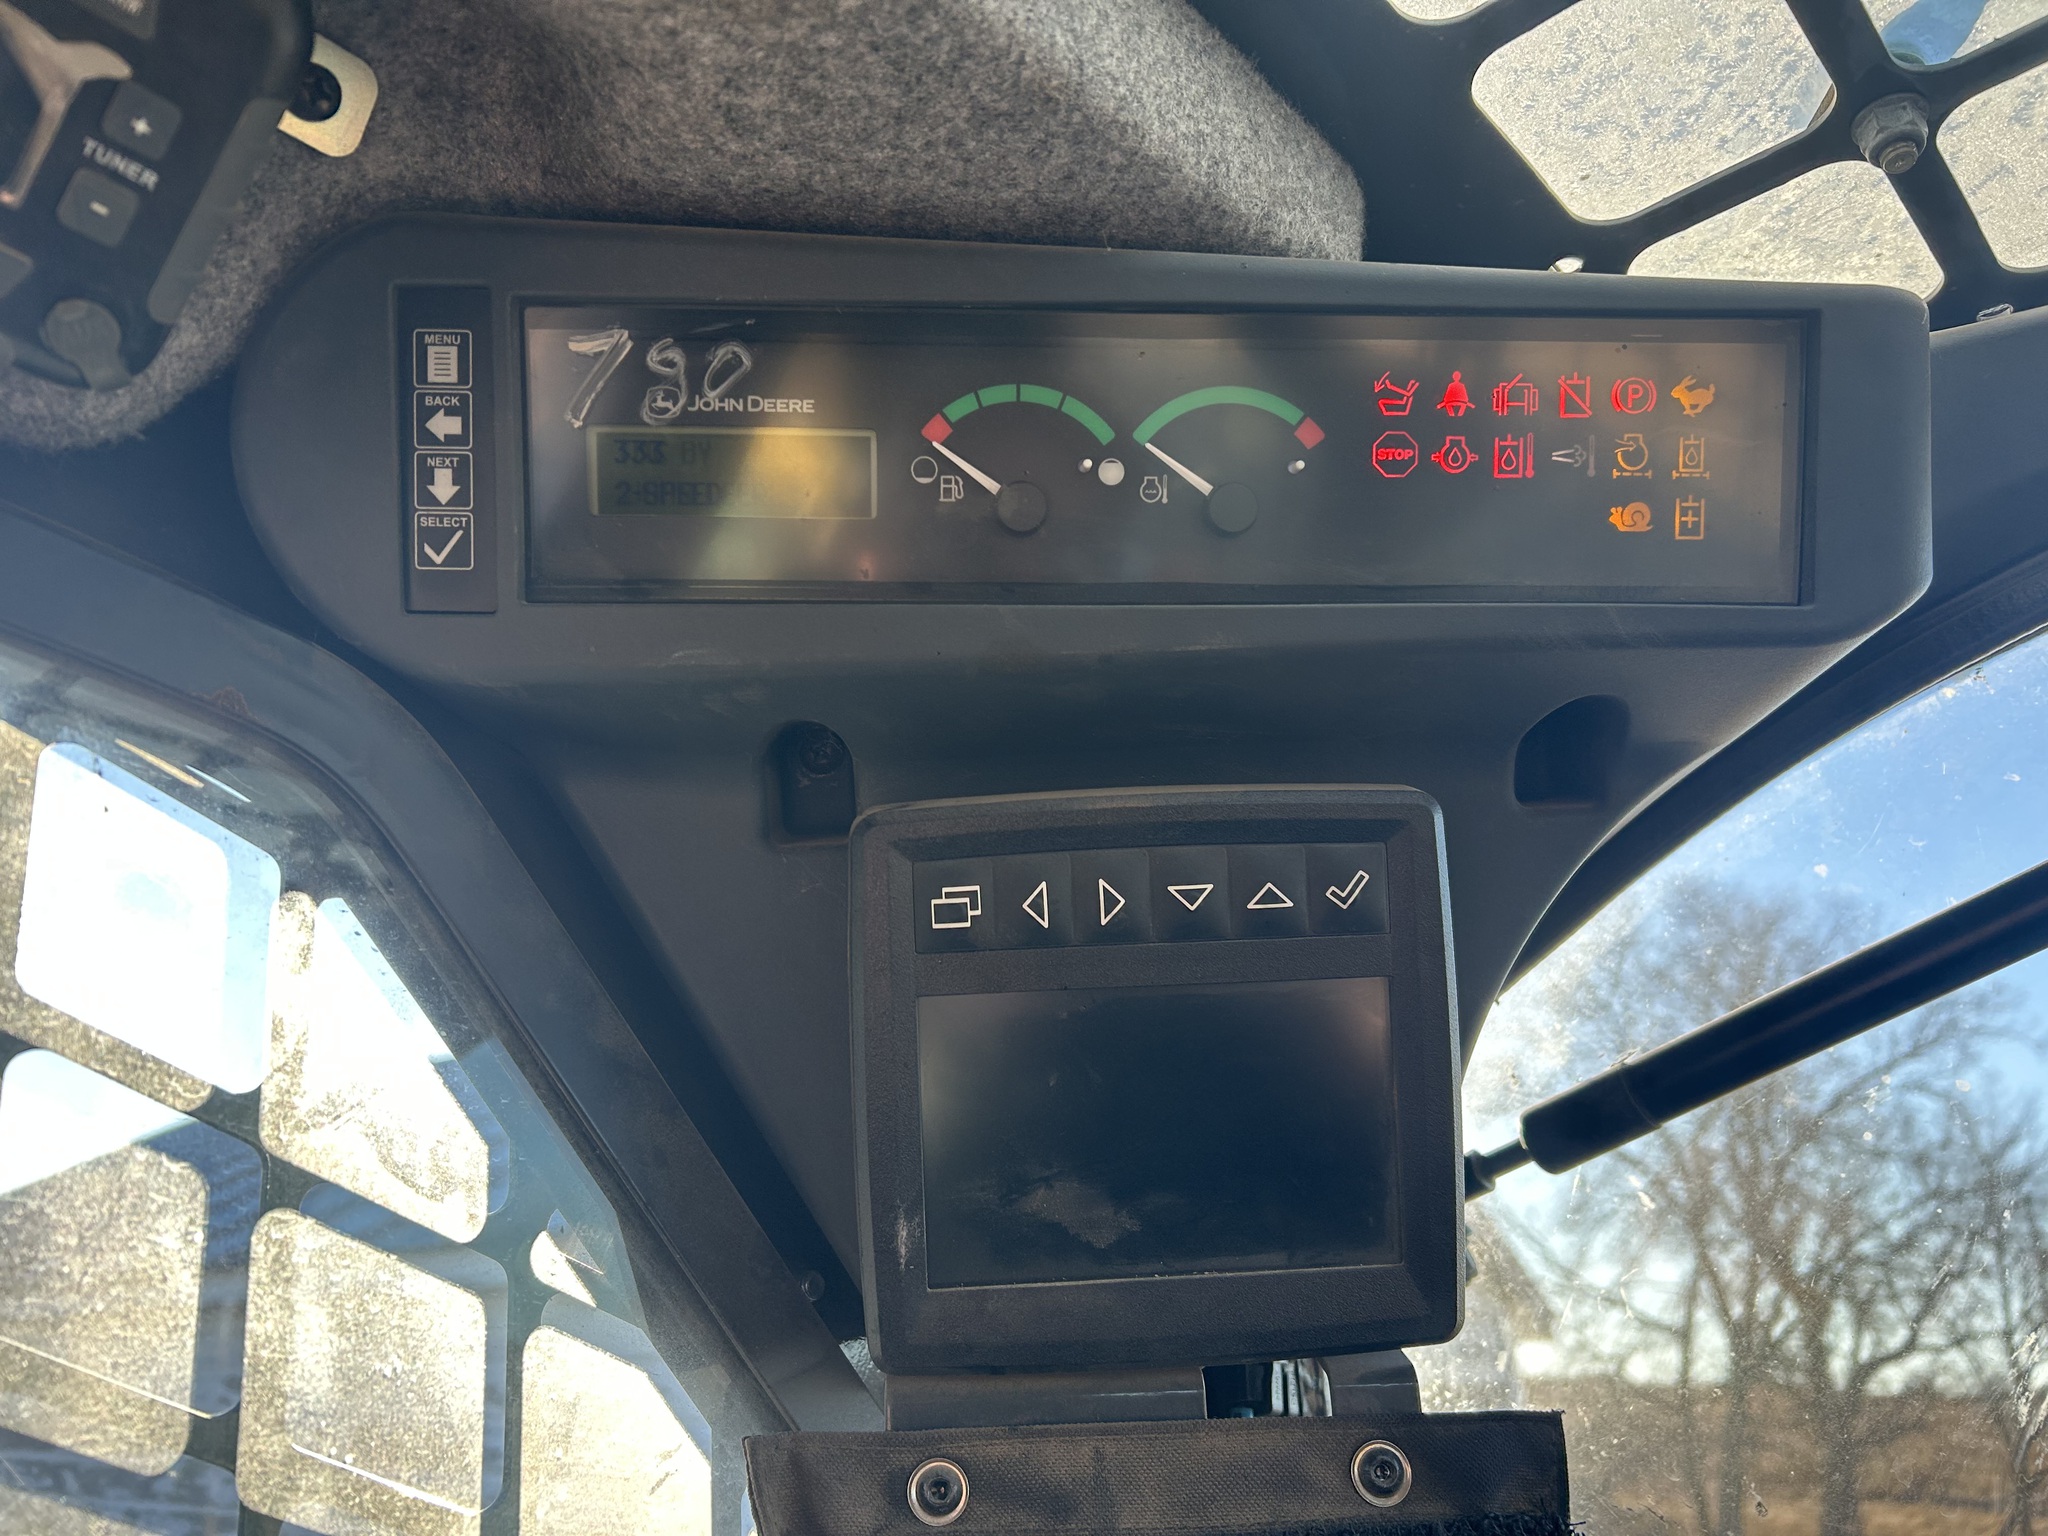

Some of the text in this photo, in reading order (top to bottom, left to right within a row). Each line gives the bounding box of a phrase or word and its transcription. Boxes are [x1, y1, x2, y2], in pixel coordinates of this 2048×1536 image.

[82, 135, 160, 191] TUNER
[424, 334, 461, 345] MENU
[425, 396, 460, 407] BACK
[687, 394, 815, 413] JOHN DEERE
[1377, 449, 1414, 462] STOP
[427, 457, 459, 468] NEXT
[420, 516, 468, 528] SELECT
